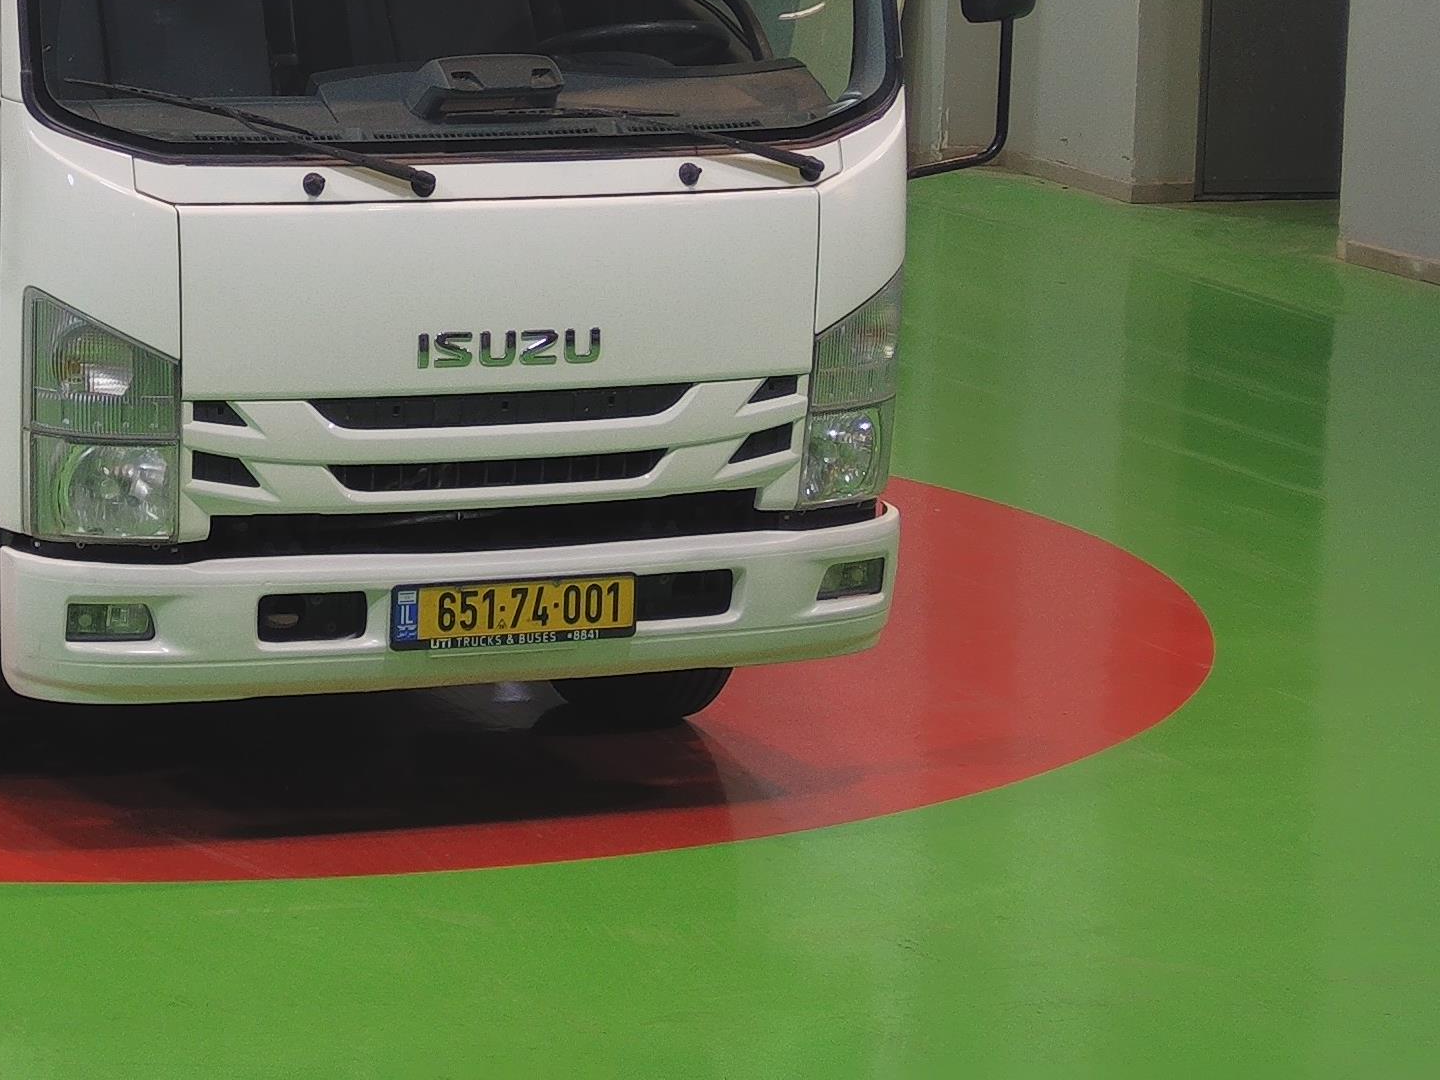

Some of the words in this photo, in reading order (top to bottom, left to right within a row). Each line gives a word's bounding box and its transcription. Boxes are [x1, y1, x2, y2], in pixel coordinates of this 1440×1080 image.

[417, 326, 601, 369] ISUZU
[400, 605, 413, 625] IL
[457, 636, 502, 647] TRUCKS
[507, 635, 515, 645] &
[519, 632, 557, 644] BUSES
